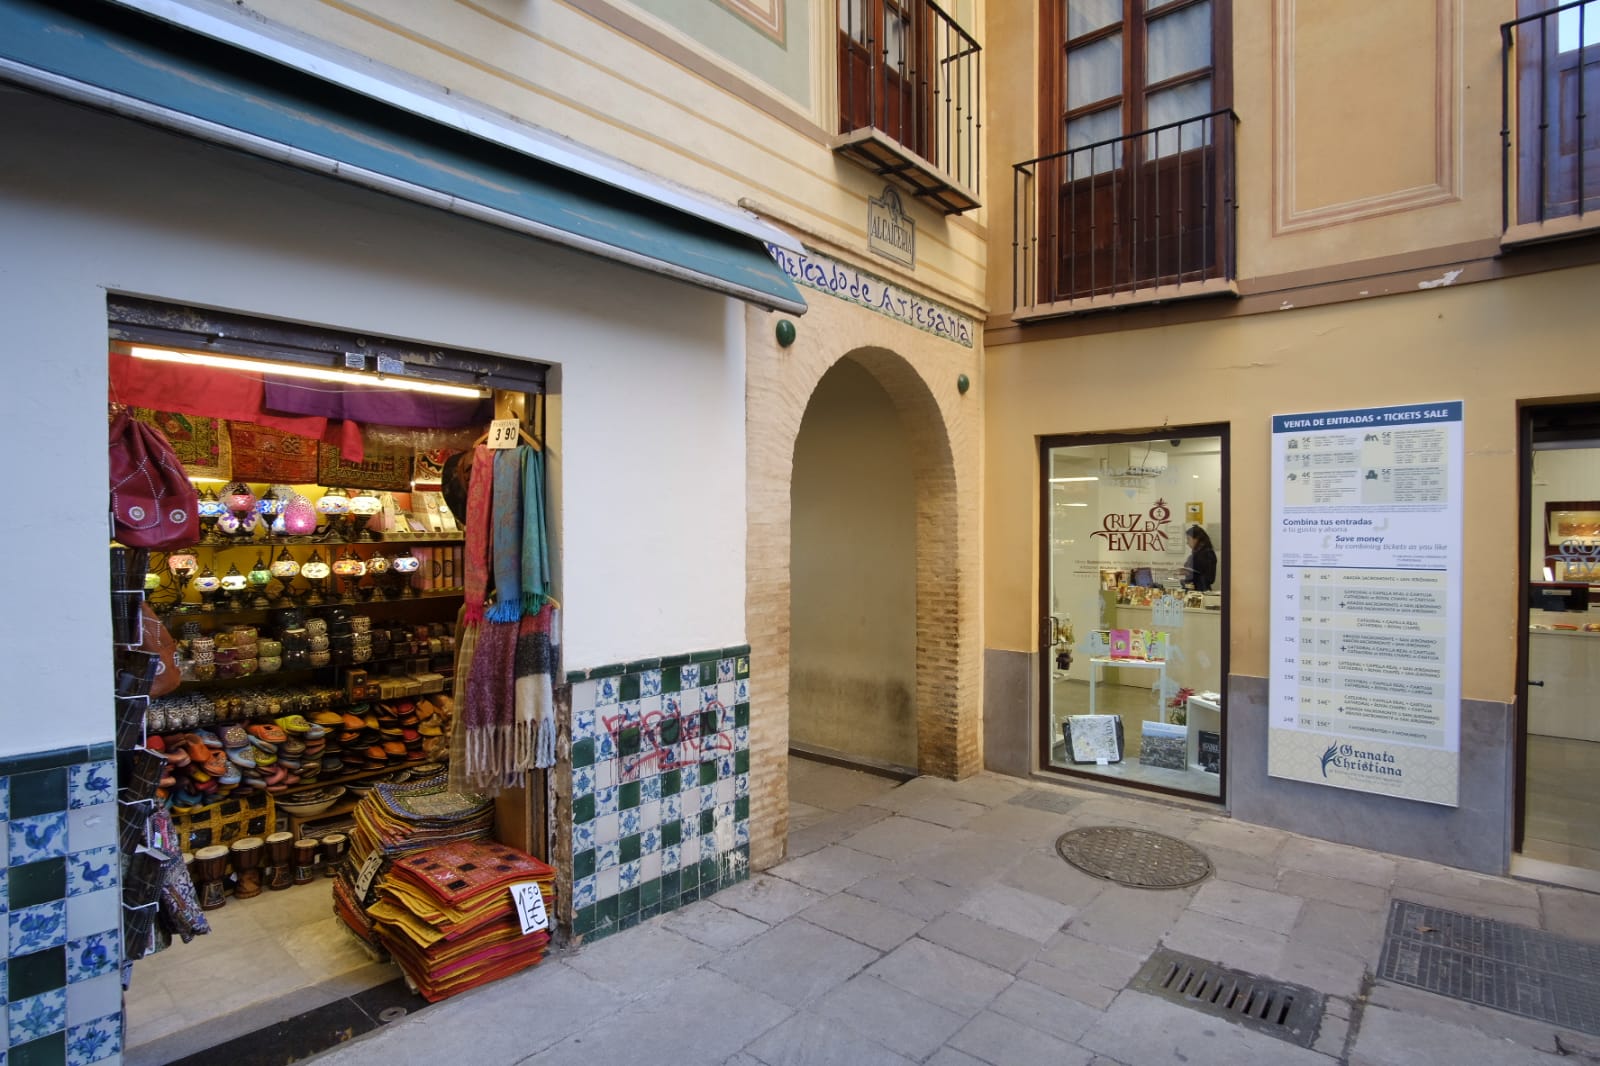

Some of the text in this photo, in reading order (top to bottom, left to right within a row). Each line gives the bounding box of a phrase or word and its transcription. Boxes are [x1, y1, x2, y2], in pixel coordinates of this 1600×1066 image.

[850, 274, 873, 303] de
[1284, 420, 1311, 428] VENTA
[1326, 414, 1374, 426] ENTRADAS
[1384, 411, 1422, 422] TICKETS
[1424, 409, 1448, 418] SALE
[1103, 513, 1142, 532] CRUZ
[1282, 518, 1318, 526] Combina
[1335, 518, 1372, 526] entradas
[1340, 744, 1394, 763] Granata
[1333, 755, 1402, 776] Christiana
